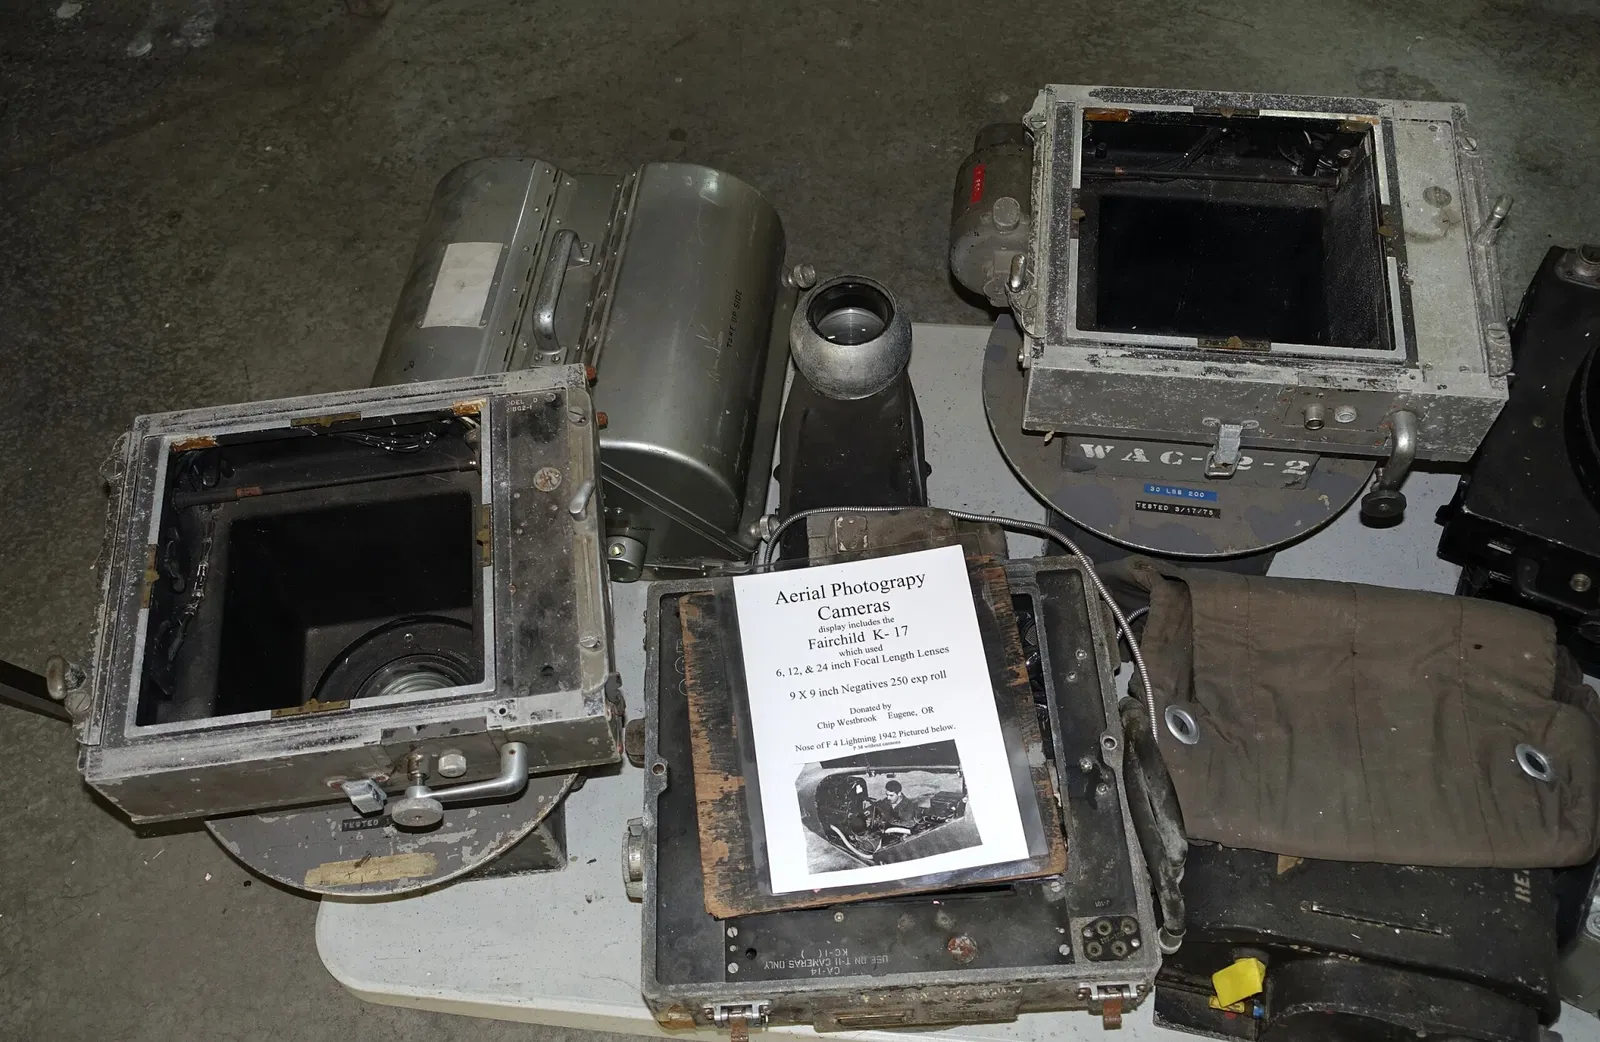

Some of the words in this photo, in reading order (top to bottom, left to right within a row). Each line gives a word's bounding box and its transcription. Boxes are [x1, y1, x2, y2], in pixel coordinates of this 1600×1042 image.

[733, 289, 742, 310] SIDE
[730, 310, 738, 323] UP
[726, 324, 737, 348] TAKE
[1188, 490, 1205, 498] 200
[1136, 502, 1169, 511] TESTED
[775, 585, 826, 605] Aerial
[830, 573, 926, 598] Photograpy
[817, 601, 891, 621] Cameras
[818, 623, 846, 634] display
[848, 618, 881, 629] includes
[882, 615, 895, 624] the
[808, 631, 866, 650] Fairchild
[894, 625, 909, 638] 17
[838, 647, 863, 658] which
[864, 643, 884, 654] used
[775, 669, 785, 678] 6,
[788, 666, 803, 676] 12,
[805, 664, 814, 674] &
[816, 663, 829, 673] 24
[831, 659, 851, 670] inch
[853, 655, 880, 667] Focal
[881, 650, 915, 664] Length
[917, 645, 950, 658] Lenses
[789, 692, 796, 701] 9
[799, 690, 808, 700] X
[809, 688, 817, 698] 9
[818, 685, 839, 697] inch
[841, 679, 889, 695] Negatives
[890, 676, 909, 687] 250
[910, 673, 929, 685] exp
[930, 670, 948, 680] roll
[816, 721, 836, 731] Chip
[836, 714, 878, 727] Westbrook
[887, 709, 918, 721] Eugene,
[921, 705, 935, 715] OR
[849, 703, 881, 715] Donated
[881, 702, 892, 712] by
[795, 742, 815, 752] Nose
[816, 741, 826, 750] of
[826, 740, 832, 748] F
[833, 739, 839, 748] 4
[840, 733, 877, 747] Lightning
[878, 730, 898, 741] 1942
[898, 726, 930, 737] Pictured
[931, 722, 957, 734] below.
[764, 960, 785, 970] ONLY
[788, 957, 832, 969] CAMERAS
[854, 955, 867, 965] ON
[810, 966, 841, 976] CA-14
